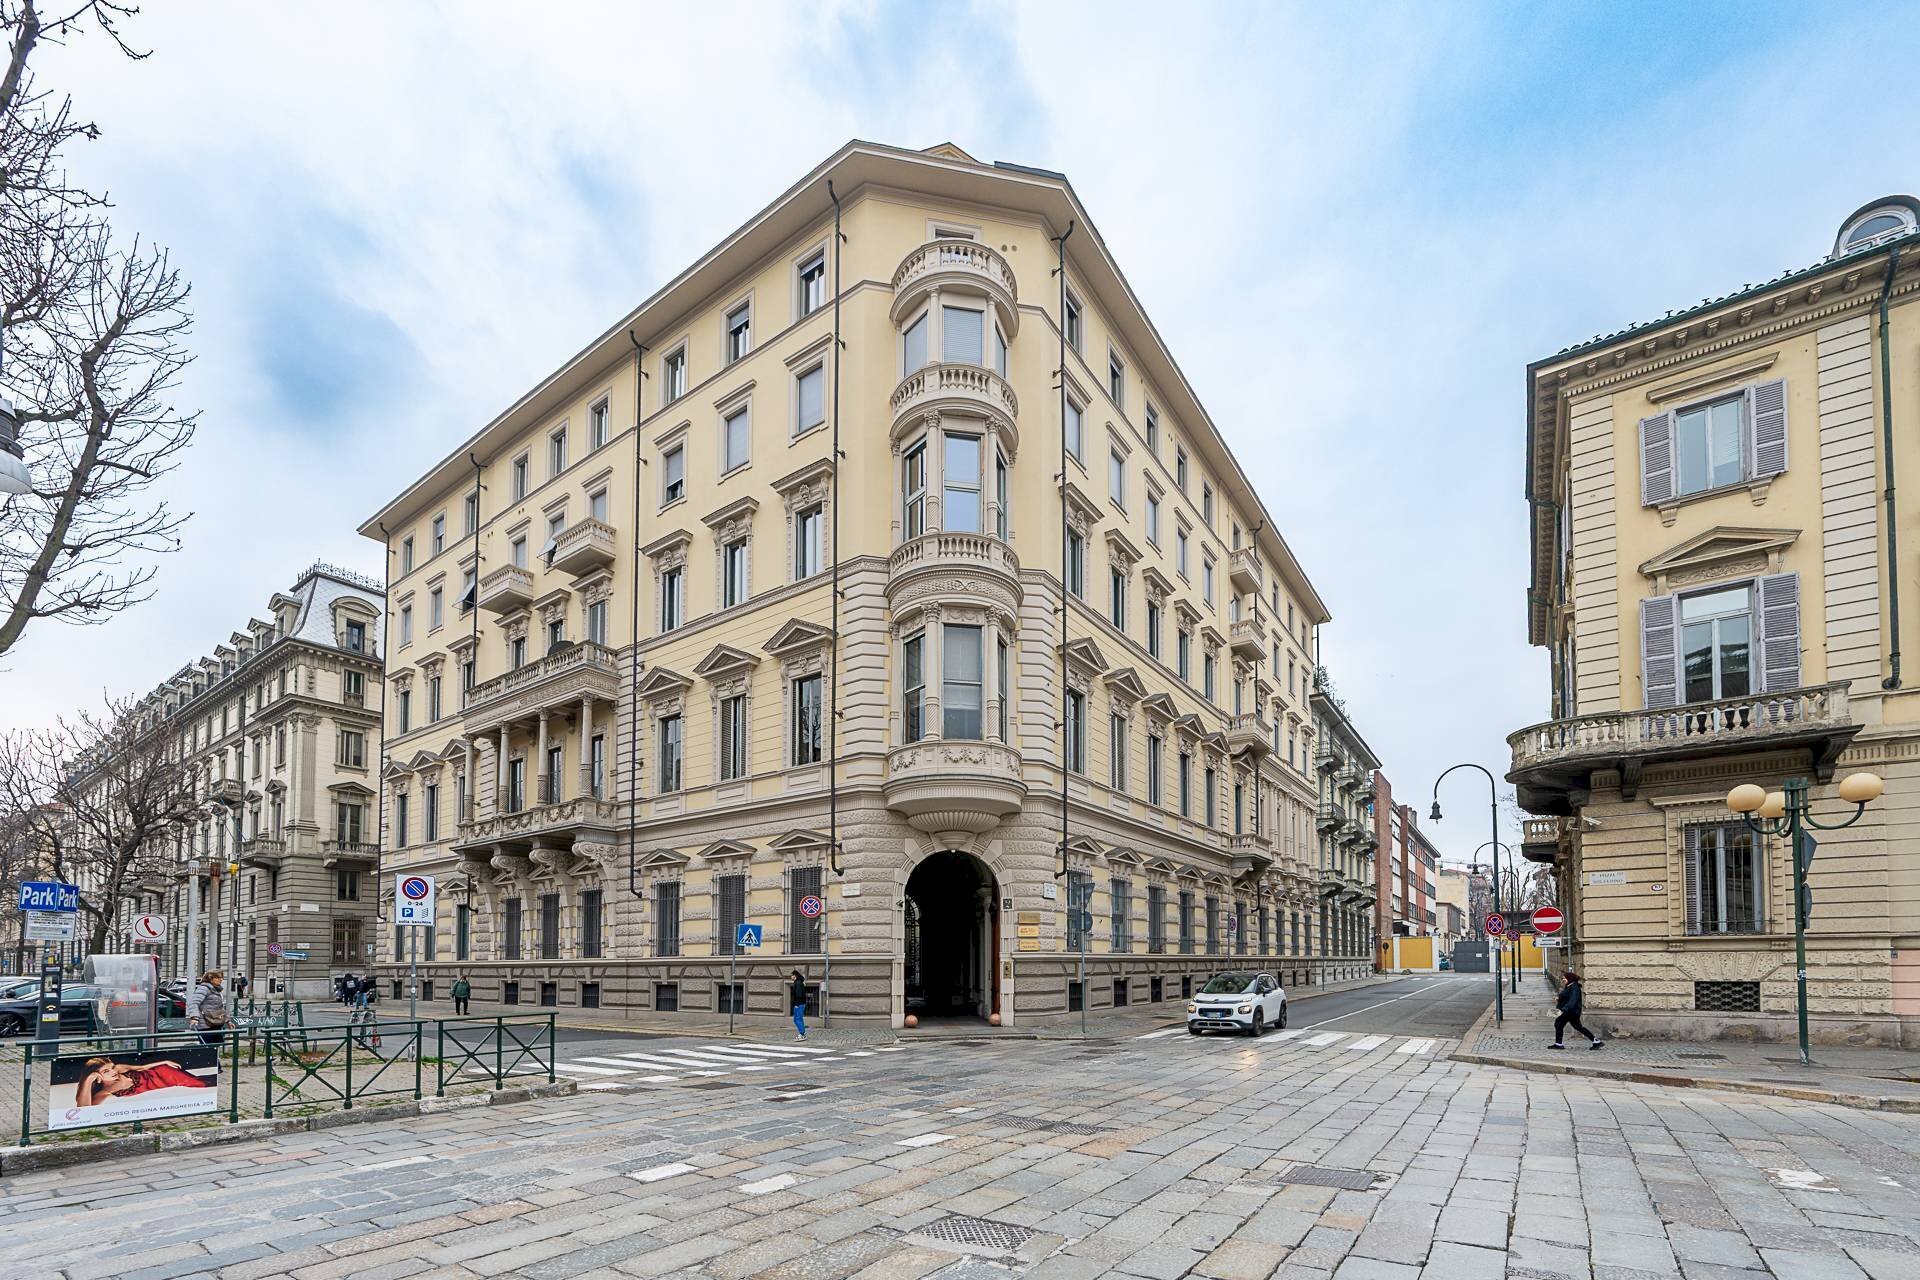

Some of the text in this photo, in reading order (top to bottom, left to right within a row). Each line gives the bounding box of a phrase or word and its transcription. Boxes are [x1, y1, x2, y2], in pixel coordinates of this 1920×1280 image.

[21, 886, 55, 906] Park
[58, 888, 77, 908] Park
[404, 909, 411, 917] P
[103, 1110, 130, 1118] CORSO
[159, 1102, 201, 1111] MARGHERITA
